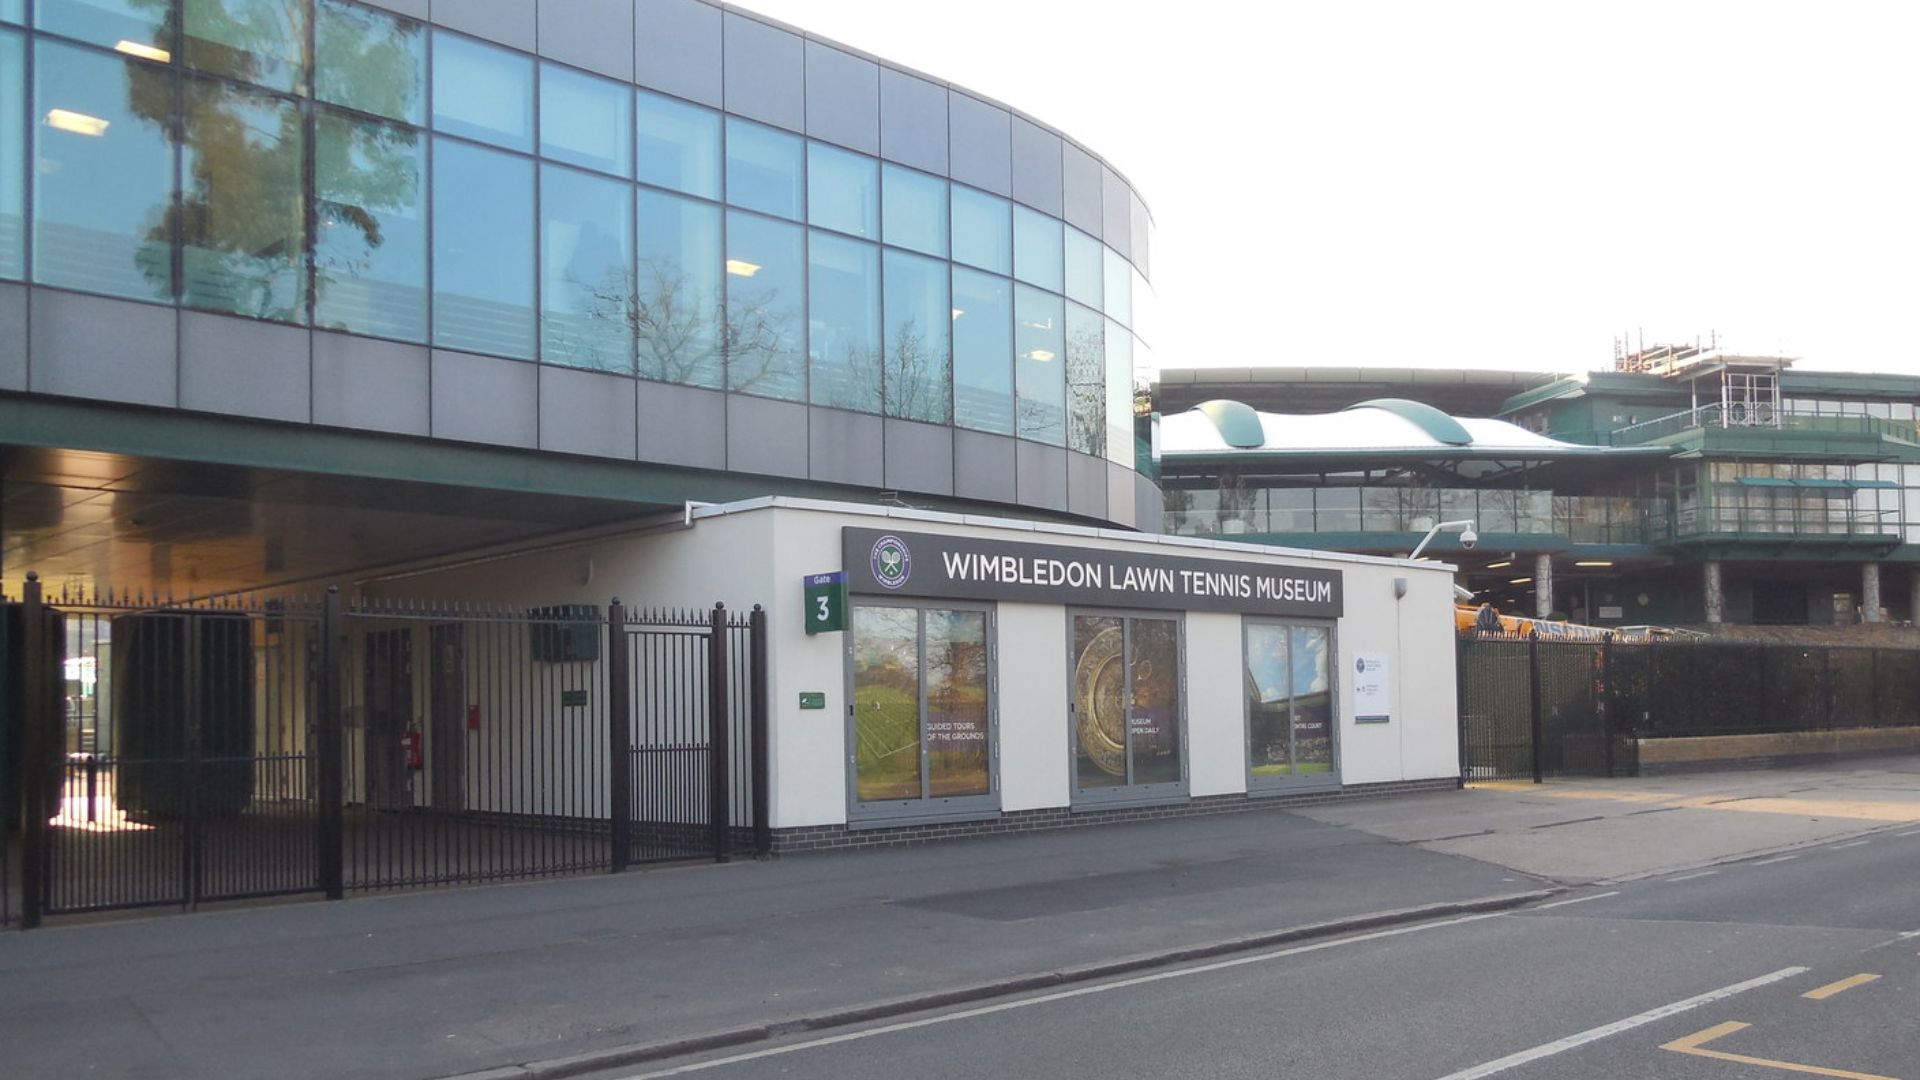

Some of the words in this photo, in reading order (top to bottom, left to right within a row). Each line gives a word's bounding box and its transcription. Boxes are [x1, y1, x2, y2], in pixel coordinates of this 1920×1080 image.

[813, 575, 831, 585] Gate
[942, 551, 1102, 588] WIMBLEDON
[1109, 564, 1174, 593] LAWN
[1180, 570, 1251, 598] TENNIS
[1256, 576, 1332, 603] MUSEUM
[816, 596, 830, 621] 3
[953, 722, 975, 731] TOURS
[927, 733, 936, 741] OF
[937, 733, 951, 741] THE
[951, 731, 984, 741] GROUNDS
